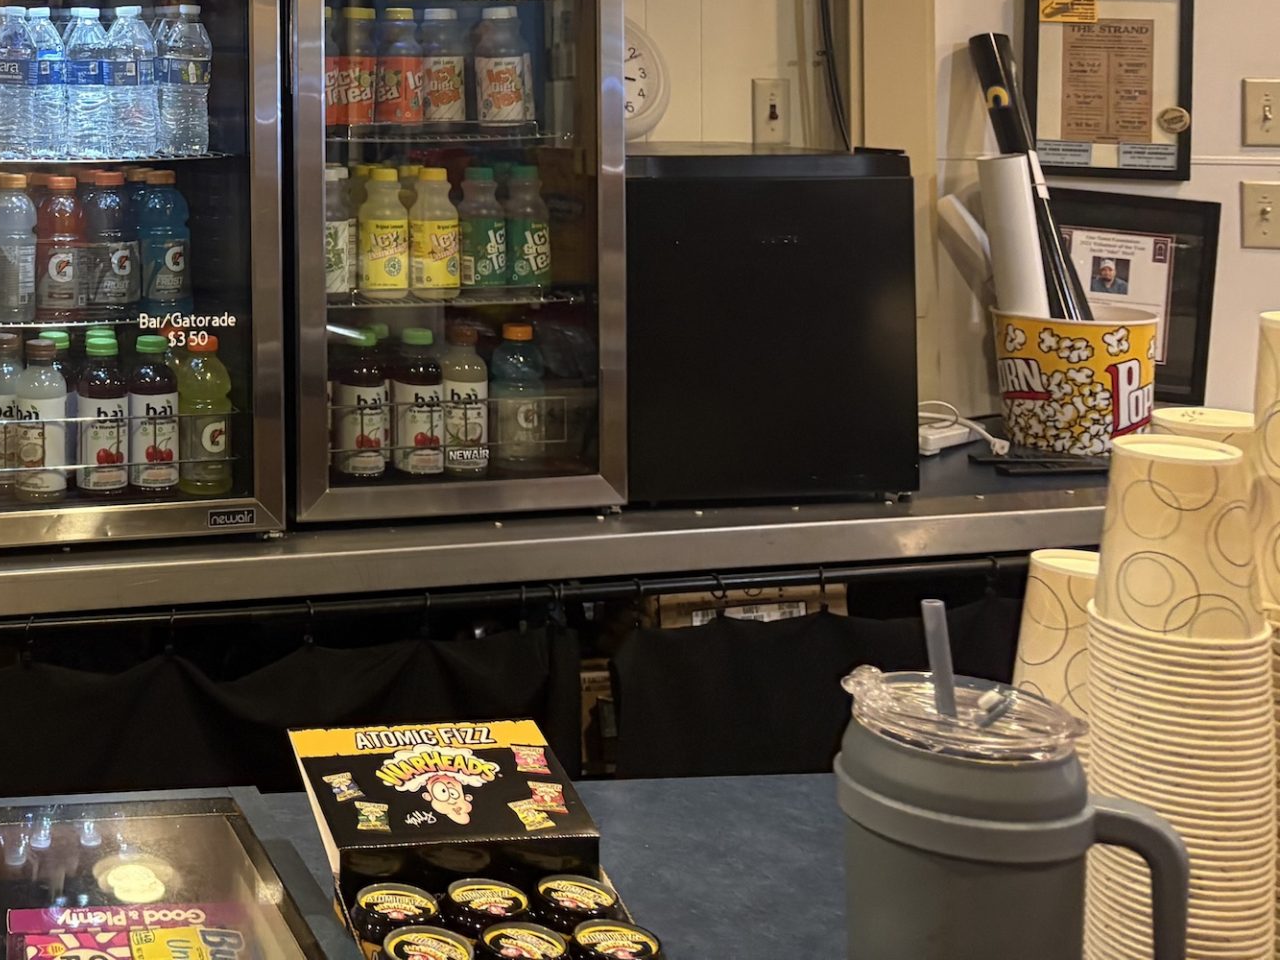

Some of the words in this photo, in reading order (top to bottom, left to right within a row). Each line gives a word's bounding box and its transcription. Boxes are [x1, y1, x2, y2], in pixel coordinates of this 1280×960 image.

[1070, 24, 1096, 33] THE
[1098, 24, 1150, 34] STRAND
[638, 67, 647, 80] 3
[637, 88, 646, 99] 4
[96, 403, 125, 424] bai
[145, 399, 174, 417] bai
[209, 510, 253, 526] newair
[354, 727, 440, 750] ATOMIC
[441, 725, 496, 746] FIZZ
[375, 750, 502, 787] WARHEADS
[56, 907, 128, 929] Plenty
[129, 911, 140, 921] &
[143, 908, 206, 924] Good
